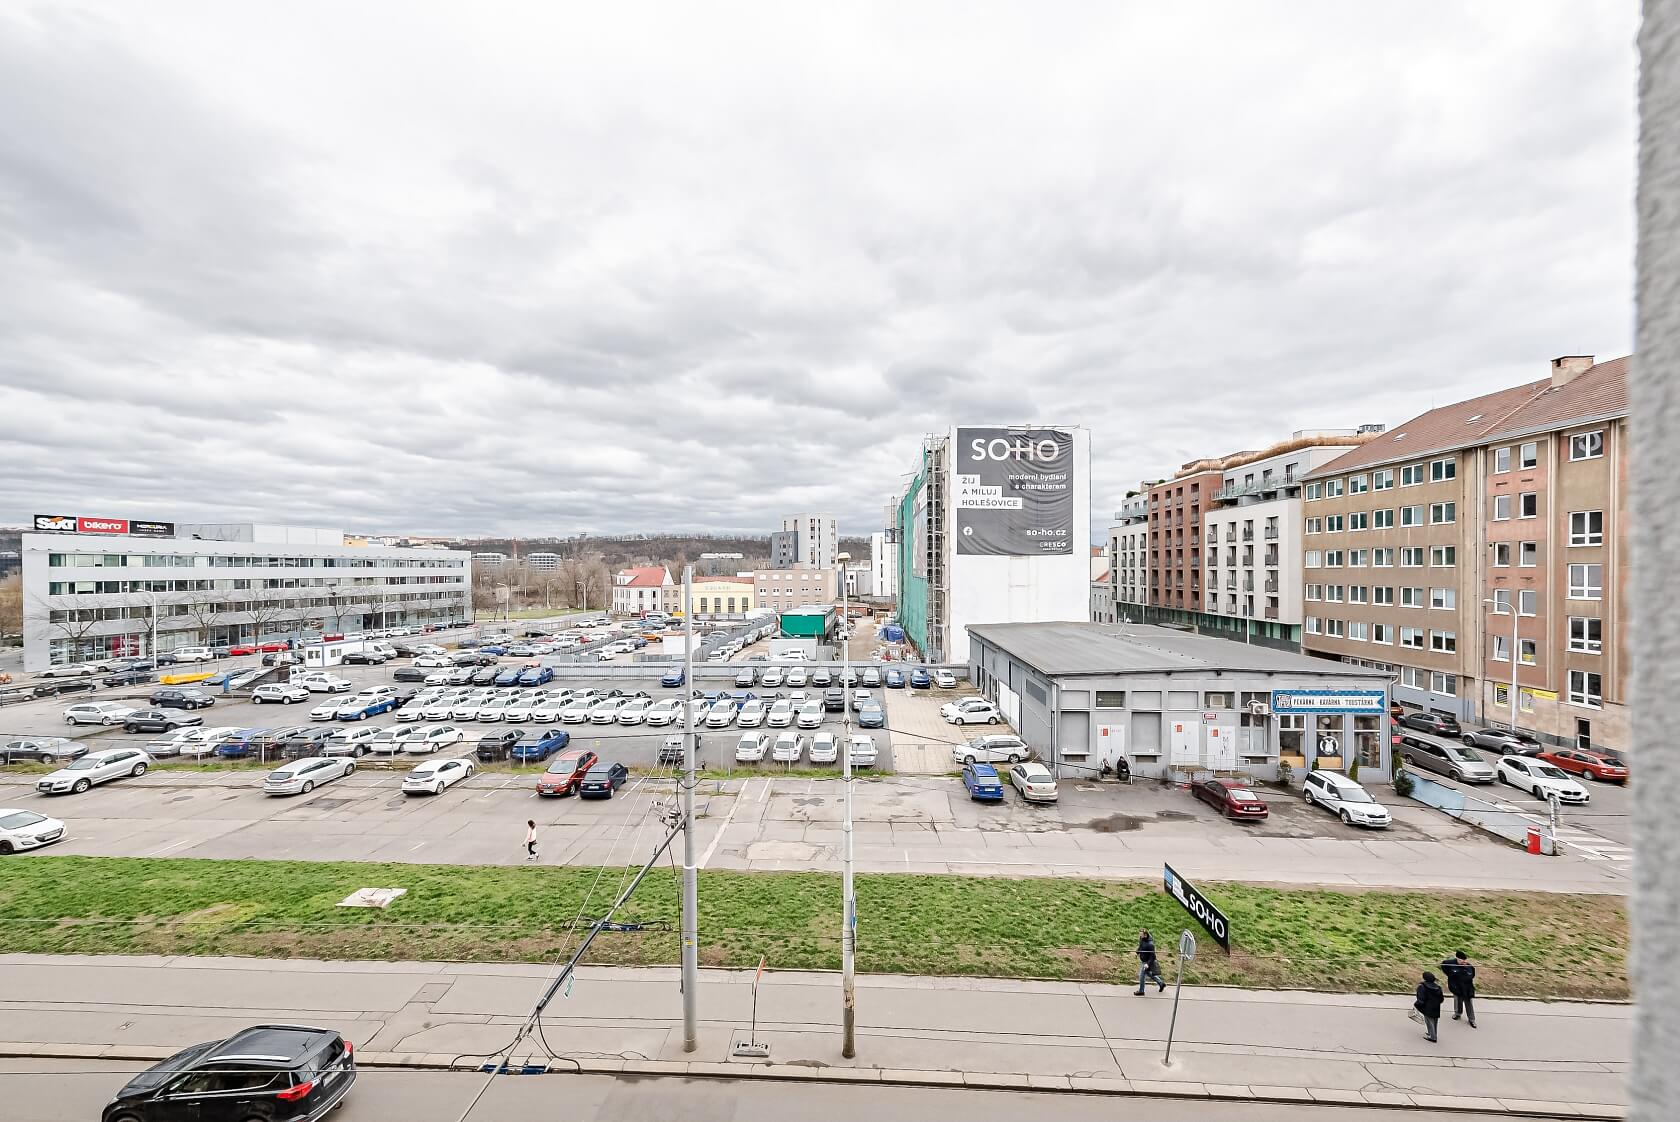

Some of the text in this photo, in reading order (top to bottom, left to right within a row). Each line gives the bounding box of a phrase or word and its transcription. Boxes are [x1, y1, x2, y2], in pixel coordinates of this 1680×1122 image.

[971, 439, 1059, 461] SOHO
[961, 498, 1019, 506] HOLEŠOVICE
[1026, 528, 1067, 536] so-ho.cz
[1190, 893, 1225, 938] SOHO
